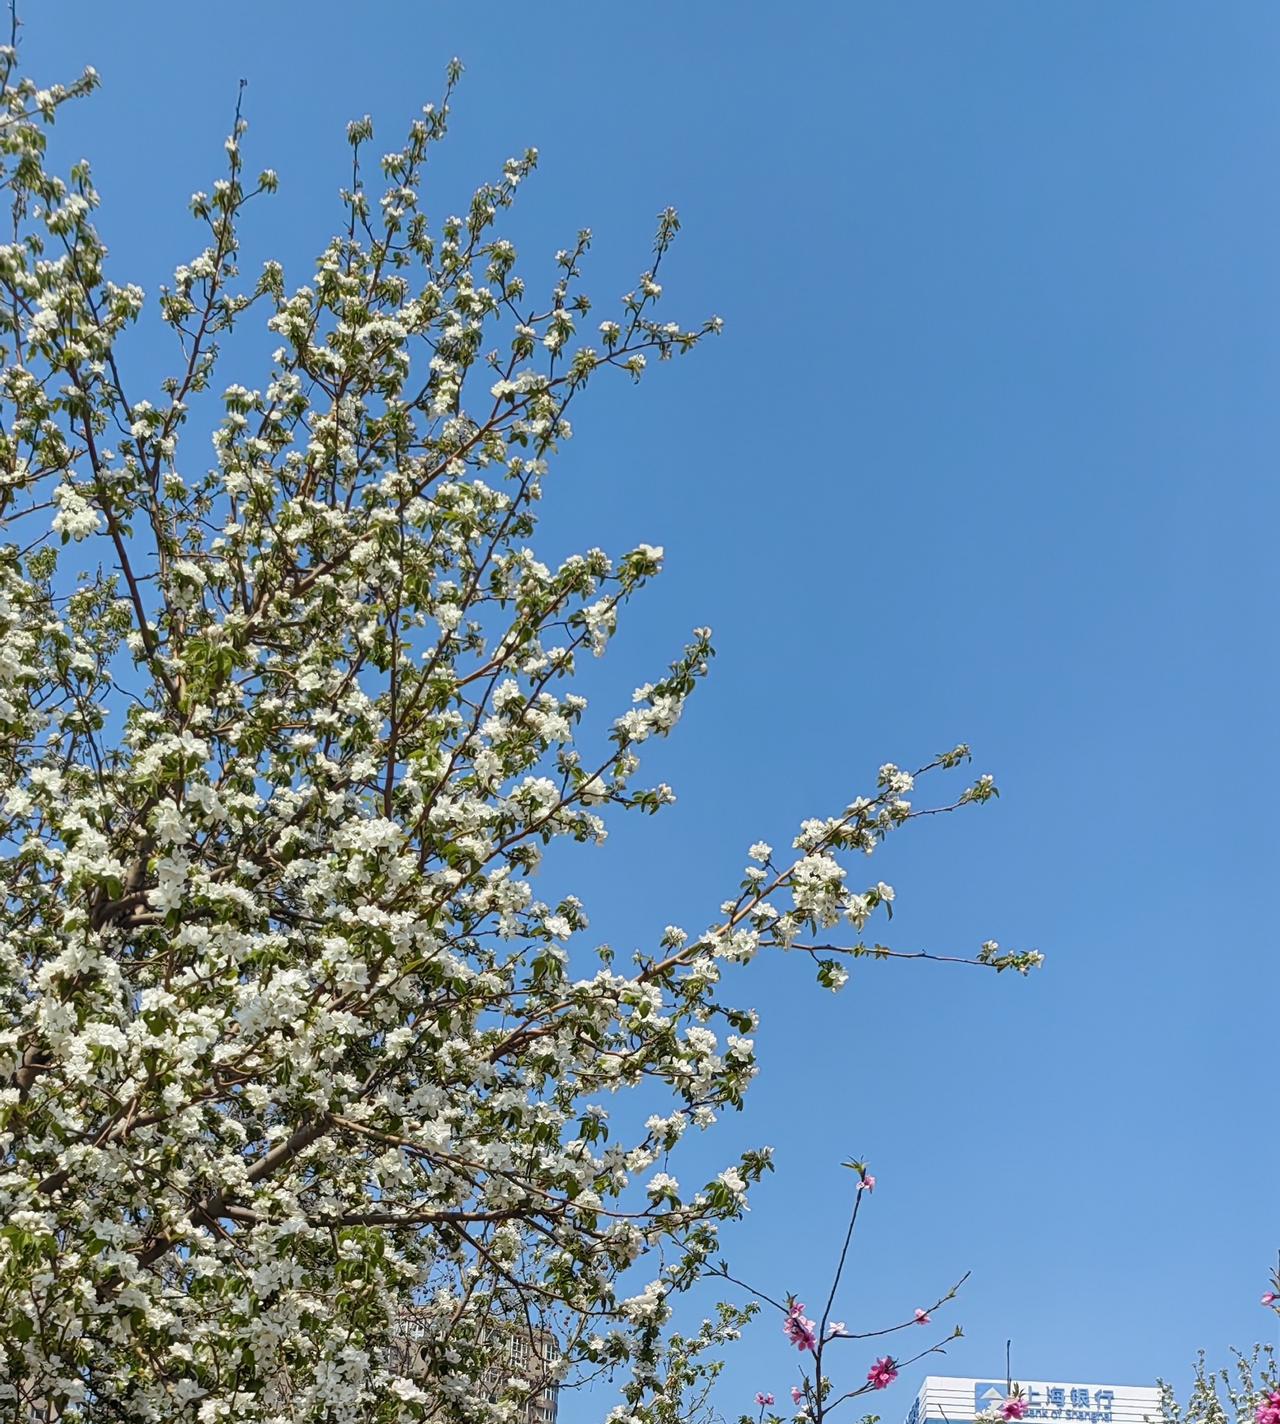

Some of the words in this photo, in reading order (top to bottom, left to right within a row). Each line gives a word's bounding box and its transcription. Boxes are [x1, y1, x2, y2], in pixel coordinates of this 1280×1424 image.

[1027, 1385, 1114, 1410] 上海银行
[1051, 1408, 1062, 1418] of
[1065, 1409, 1113, 1423] Shanghai
